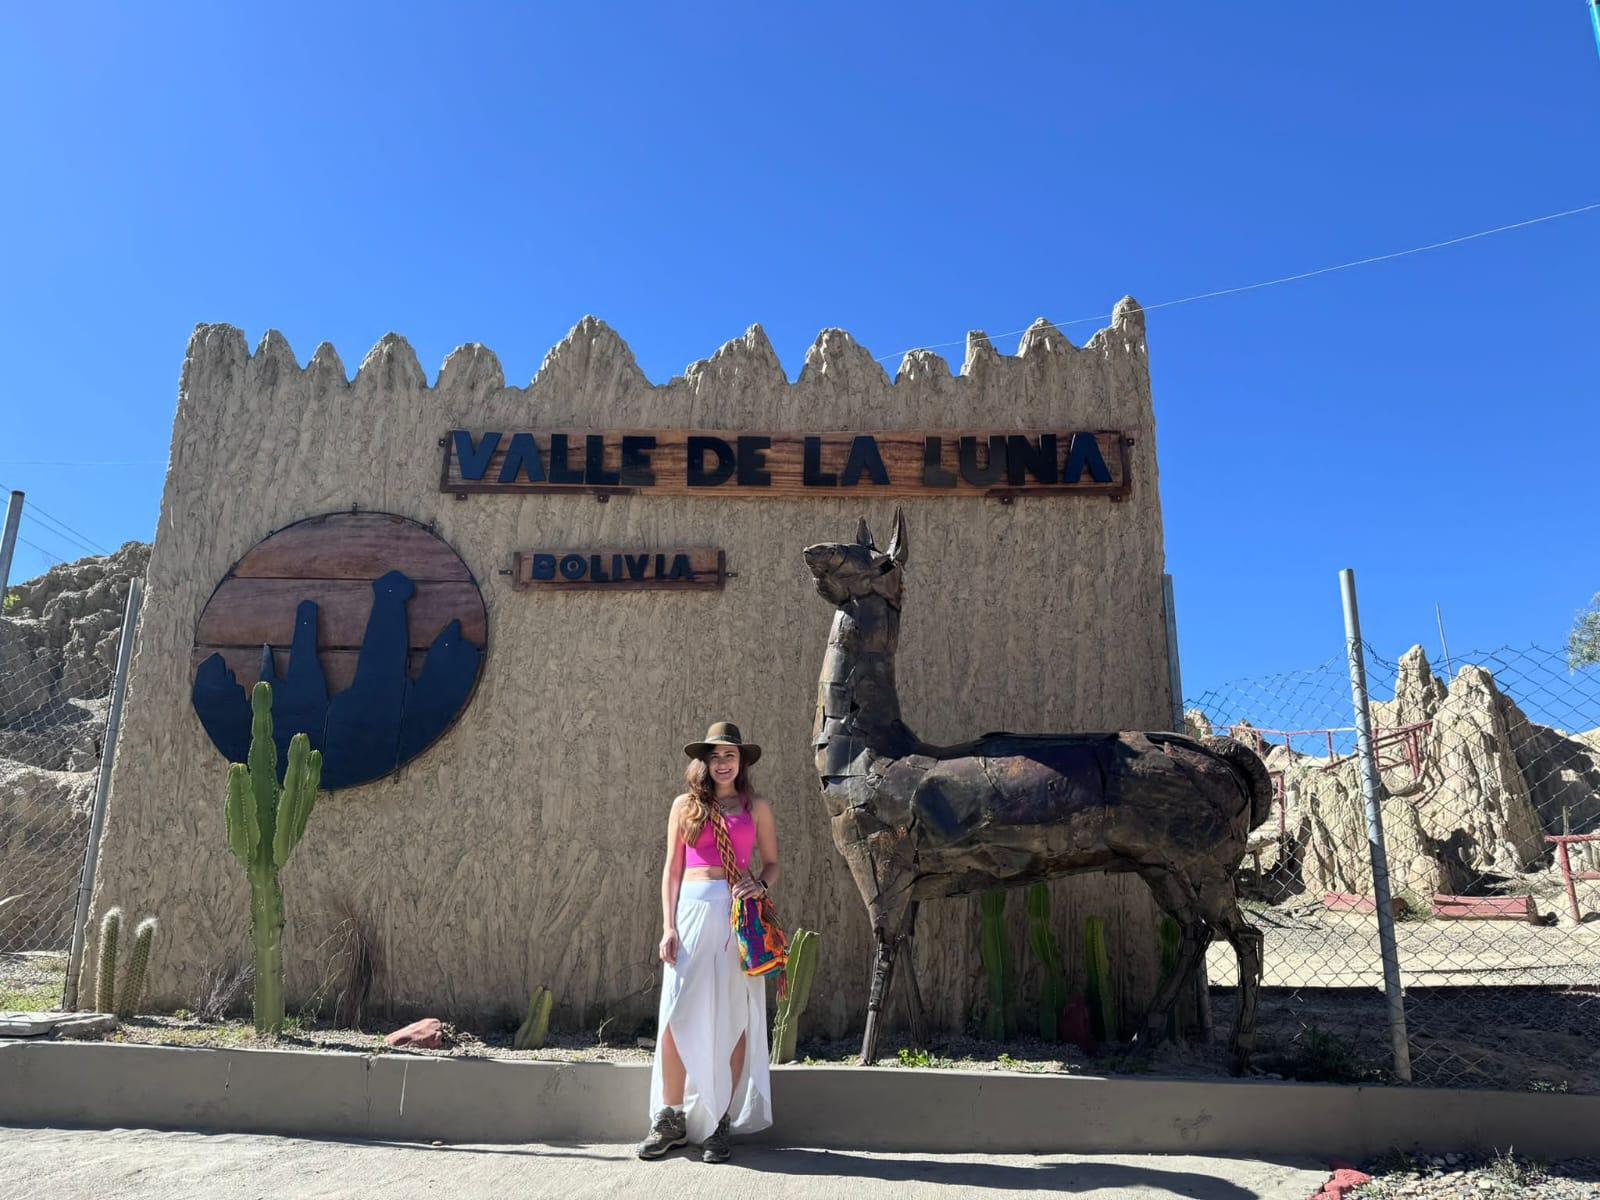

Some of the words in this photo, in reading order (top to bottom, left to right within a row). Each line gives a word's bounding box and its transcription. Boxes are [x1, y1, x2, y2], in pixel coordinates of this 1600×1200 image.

[453, 430, 656, 486] VALLE
[687, 436, 771, 486] DE
[803, 436, 890, 486] LA
[922, 431, 1113, 487] LUNA
[532, 554, 693, 582] BOLIVIA
